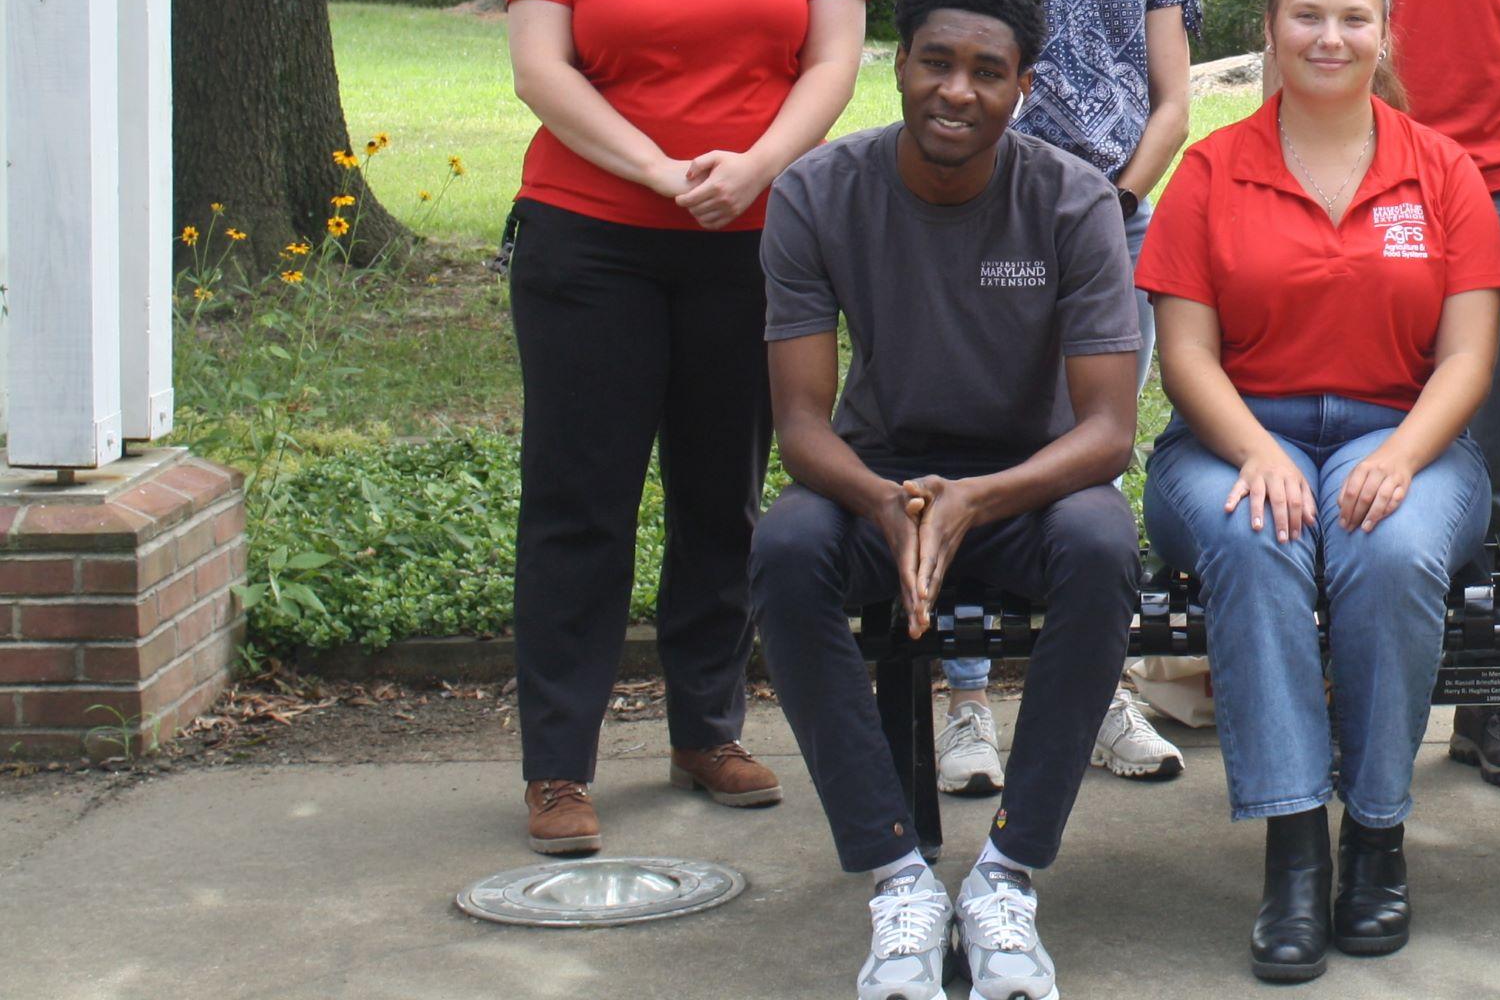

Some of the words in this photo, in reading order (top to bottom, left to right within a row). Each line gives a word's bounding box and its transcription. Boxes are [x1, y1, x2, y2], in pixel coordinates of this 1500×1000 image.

[1373, 206, 1423, 217] MARYLAND
[1374, 213, 1424, 223] EXTENSION
[1384, 227, 1423, 244] AgFS
[981, 267, 1046, 277] MARYLAND
[981, 278, 1046, 287] EXTENSION
